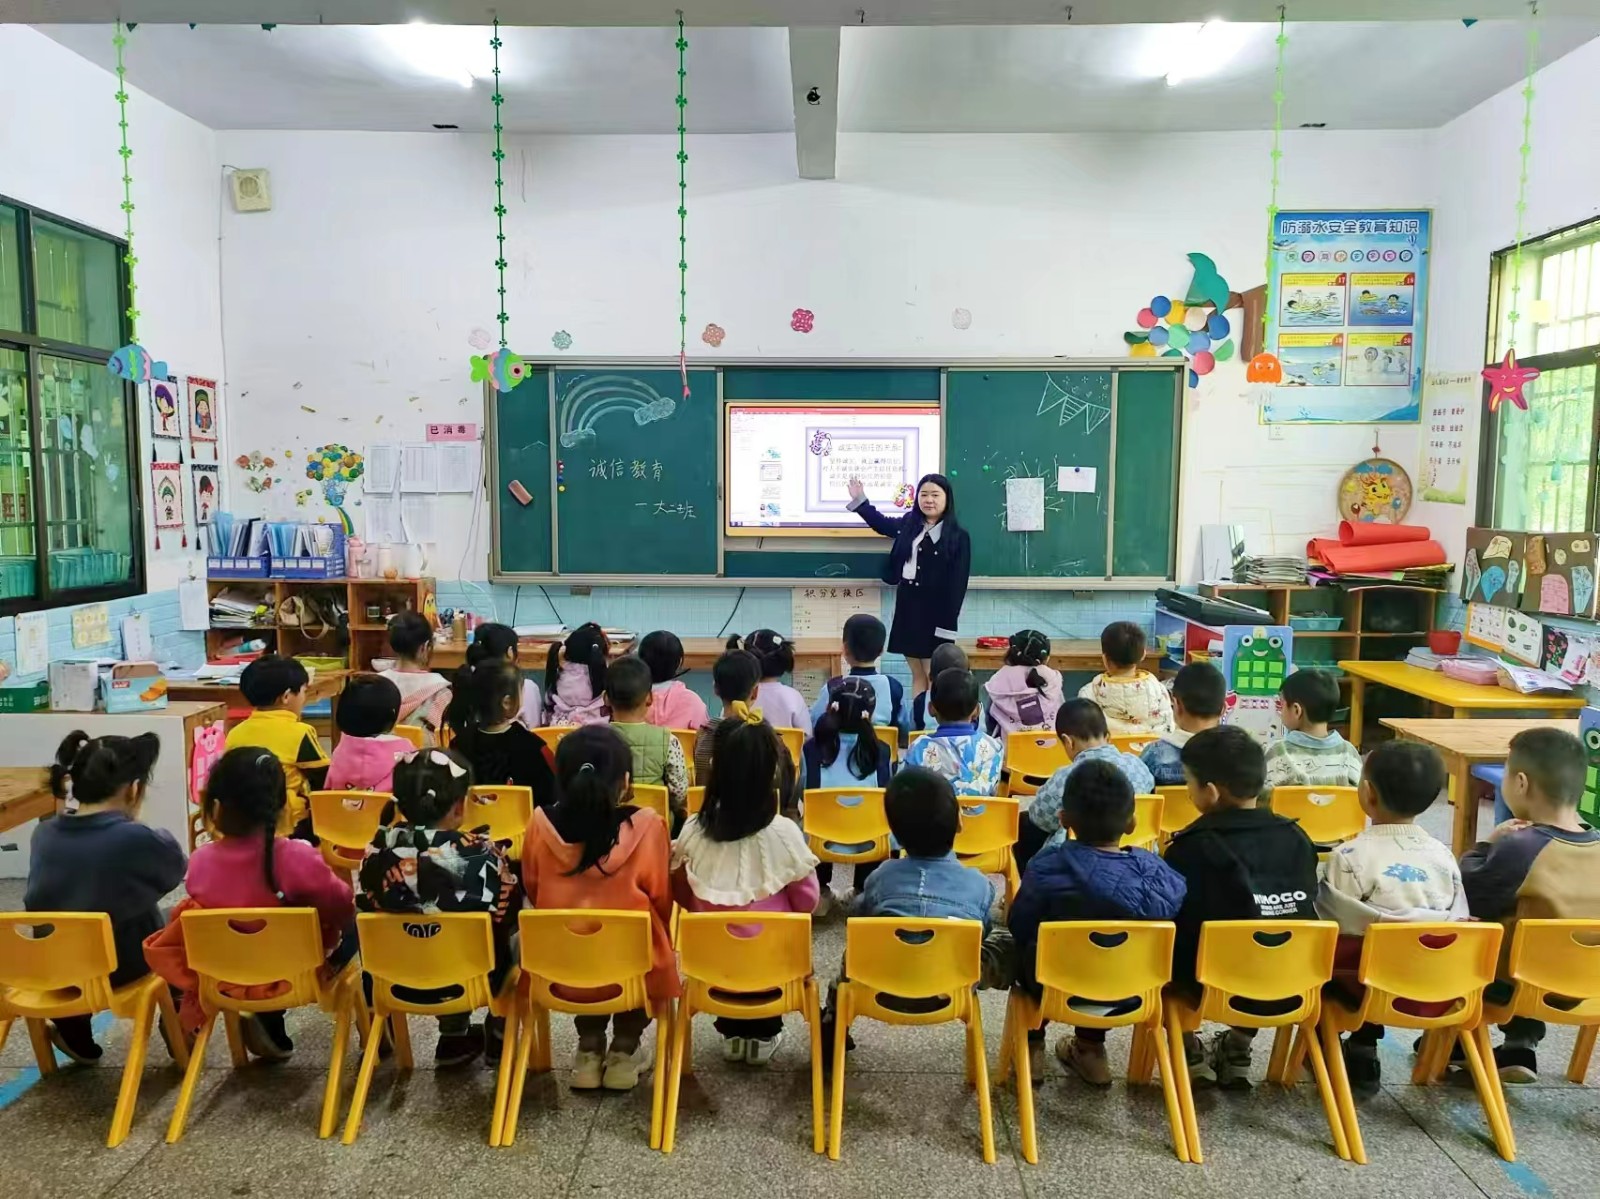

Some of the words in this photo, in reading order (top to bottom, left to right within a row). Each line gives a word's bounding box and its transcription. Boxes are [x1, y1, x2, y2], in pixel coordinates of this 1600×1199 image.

[1281, 219, 1419, 235] 防溺水安全教育知识
[430, 425, 466, 435] 已消毒
[589, 458, 663, 481] 诚信教育
